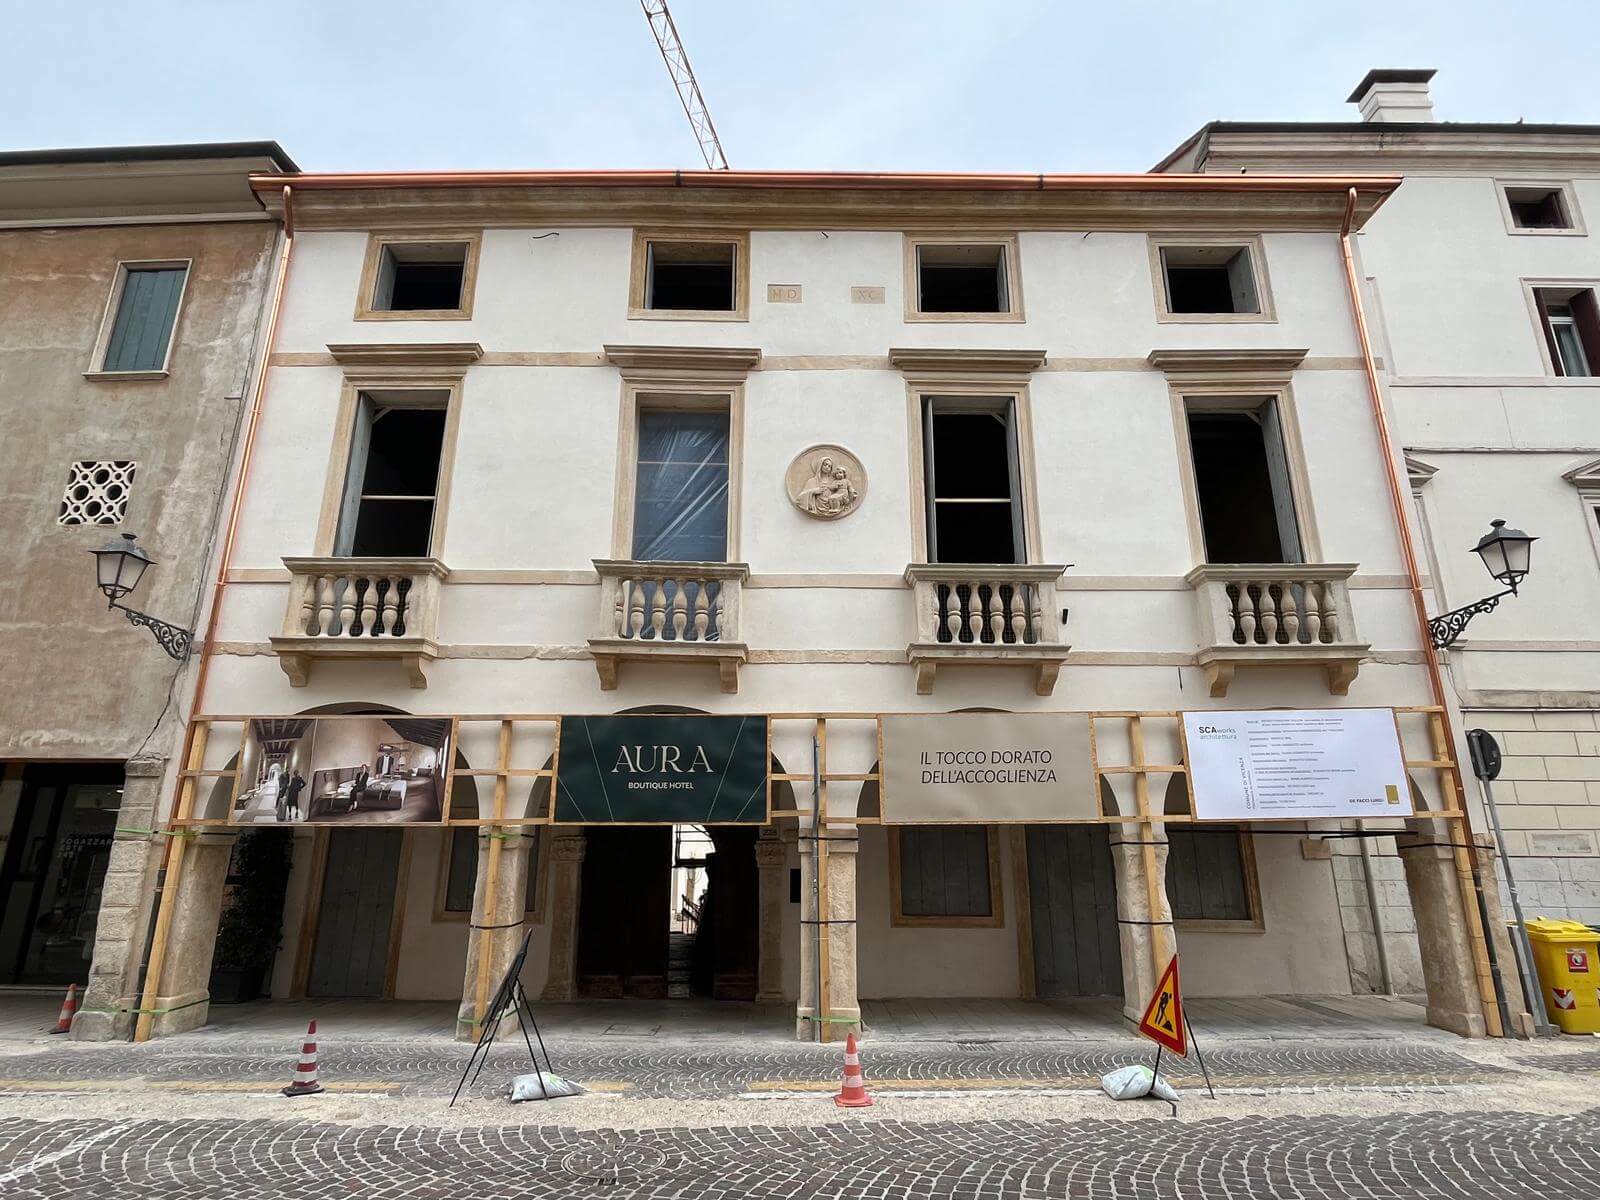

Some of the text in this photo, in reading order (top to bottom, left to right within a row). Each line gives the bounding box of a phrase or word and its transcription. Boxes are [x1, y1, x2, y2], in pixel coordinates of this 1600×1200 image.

[611, 745, 715, 773] AURA
[920, 750, 1052, 765] IL TOCCO DORATO
[921, 769, 1057, 784] DELL'ACCOGLIENZA
[628, 782, 694, 790] BOUTIQUE HOTEL
